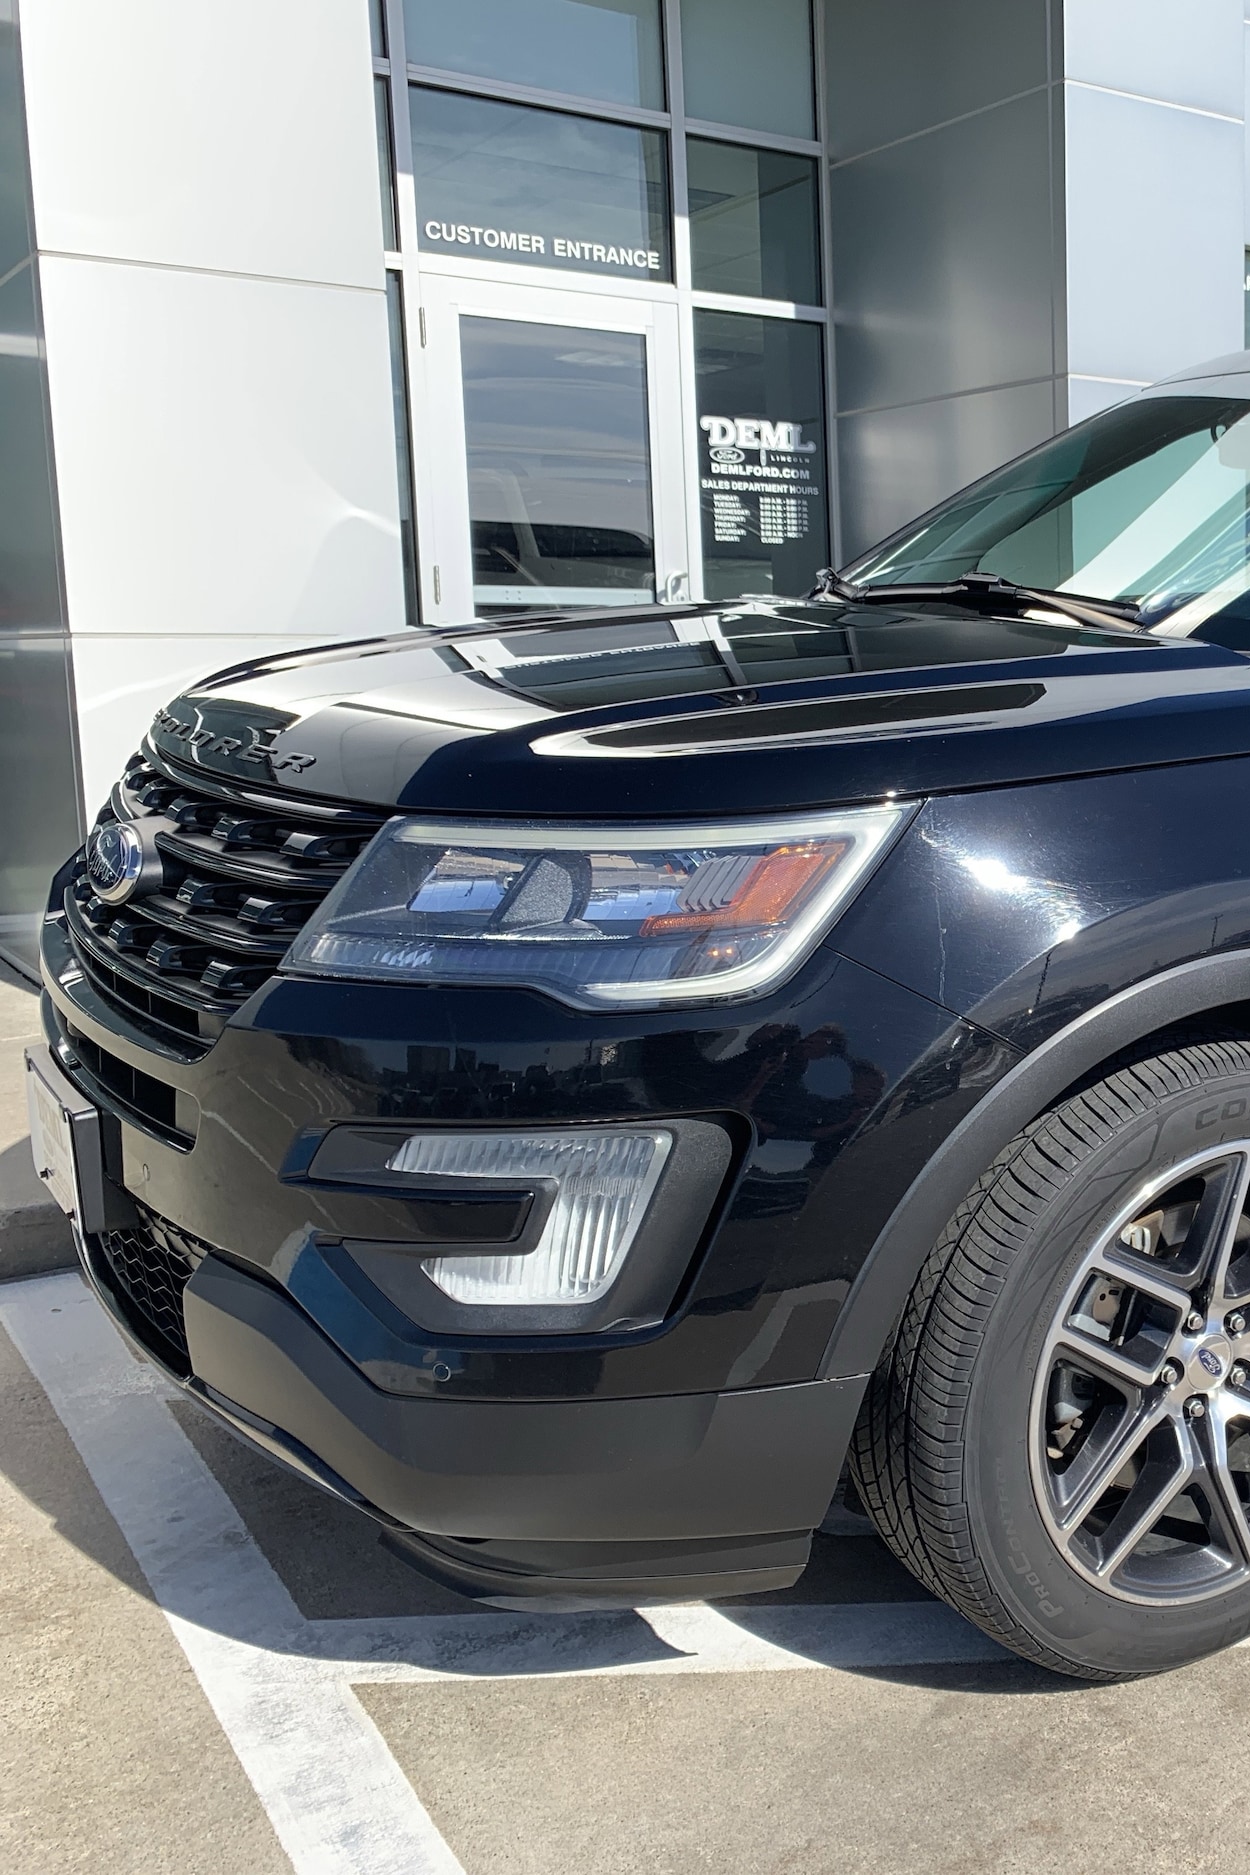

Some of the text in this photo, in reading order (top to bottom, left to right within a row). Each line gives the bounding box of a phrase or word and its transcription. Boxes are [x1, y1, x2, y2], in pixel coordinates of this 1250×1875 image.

[425, 221, 660, 270] CUSTOMER ENTRANCE
[700, 415, 817, 453] DEML
[770, 454, 810, 464] LINCOLN
[710, 462, 810, 480] DEMLFORD.COM
[701, 479, 820, 496] SALES DEPARTMENT HOURS
